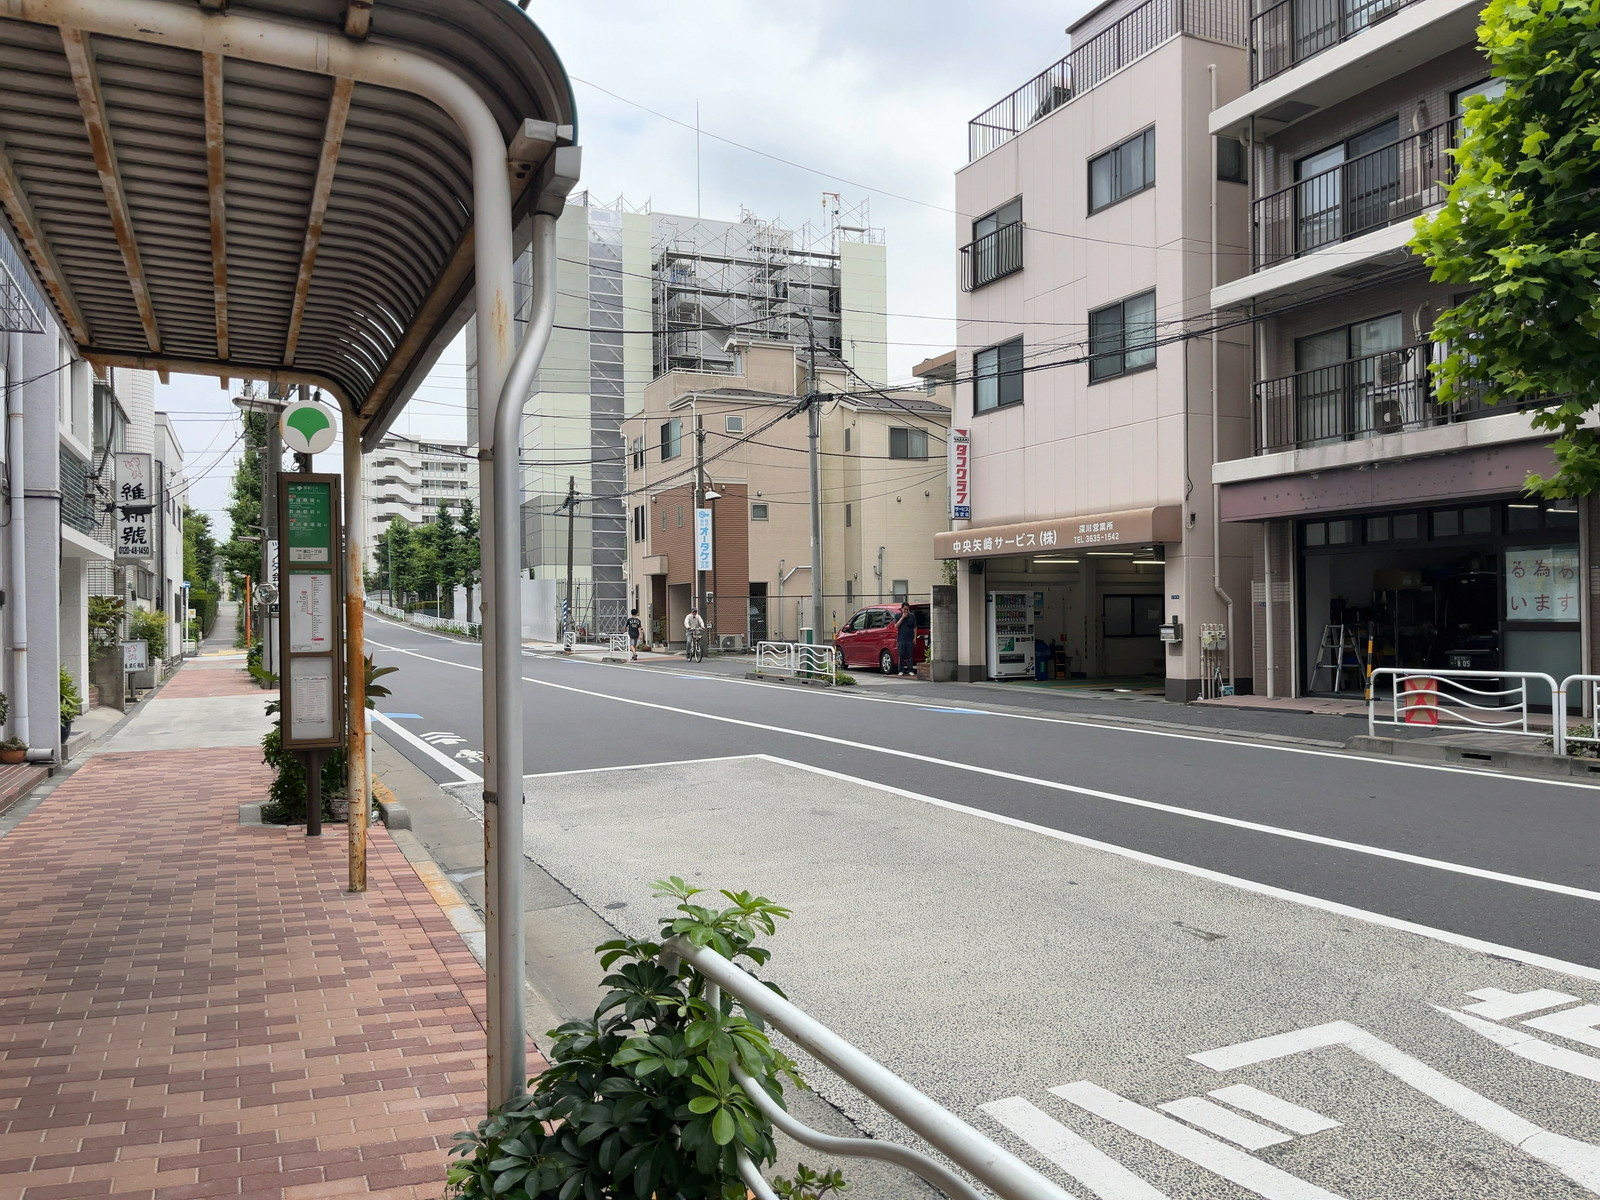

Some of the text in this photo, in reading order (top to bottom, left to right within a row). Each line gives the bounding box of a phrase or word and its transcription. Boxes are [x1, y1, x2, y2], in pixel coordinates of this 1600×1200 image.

[1079, 521, 1114, 533] 深川営業所
[700, 527, 709, 560] オータケ
[1074, 536, 1084, 544] TEL
[119, 546, 149, 555] 0120-48-1450
[1511, 593, 1575, 612] います
